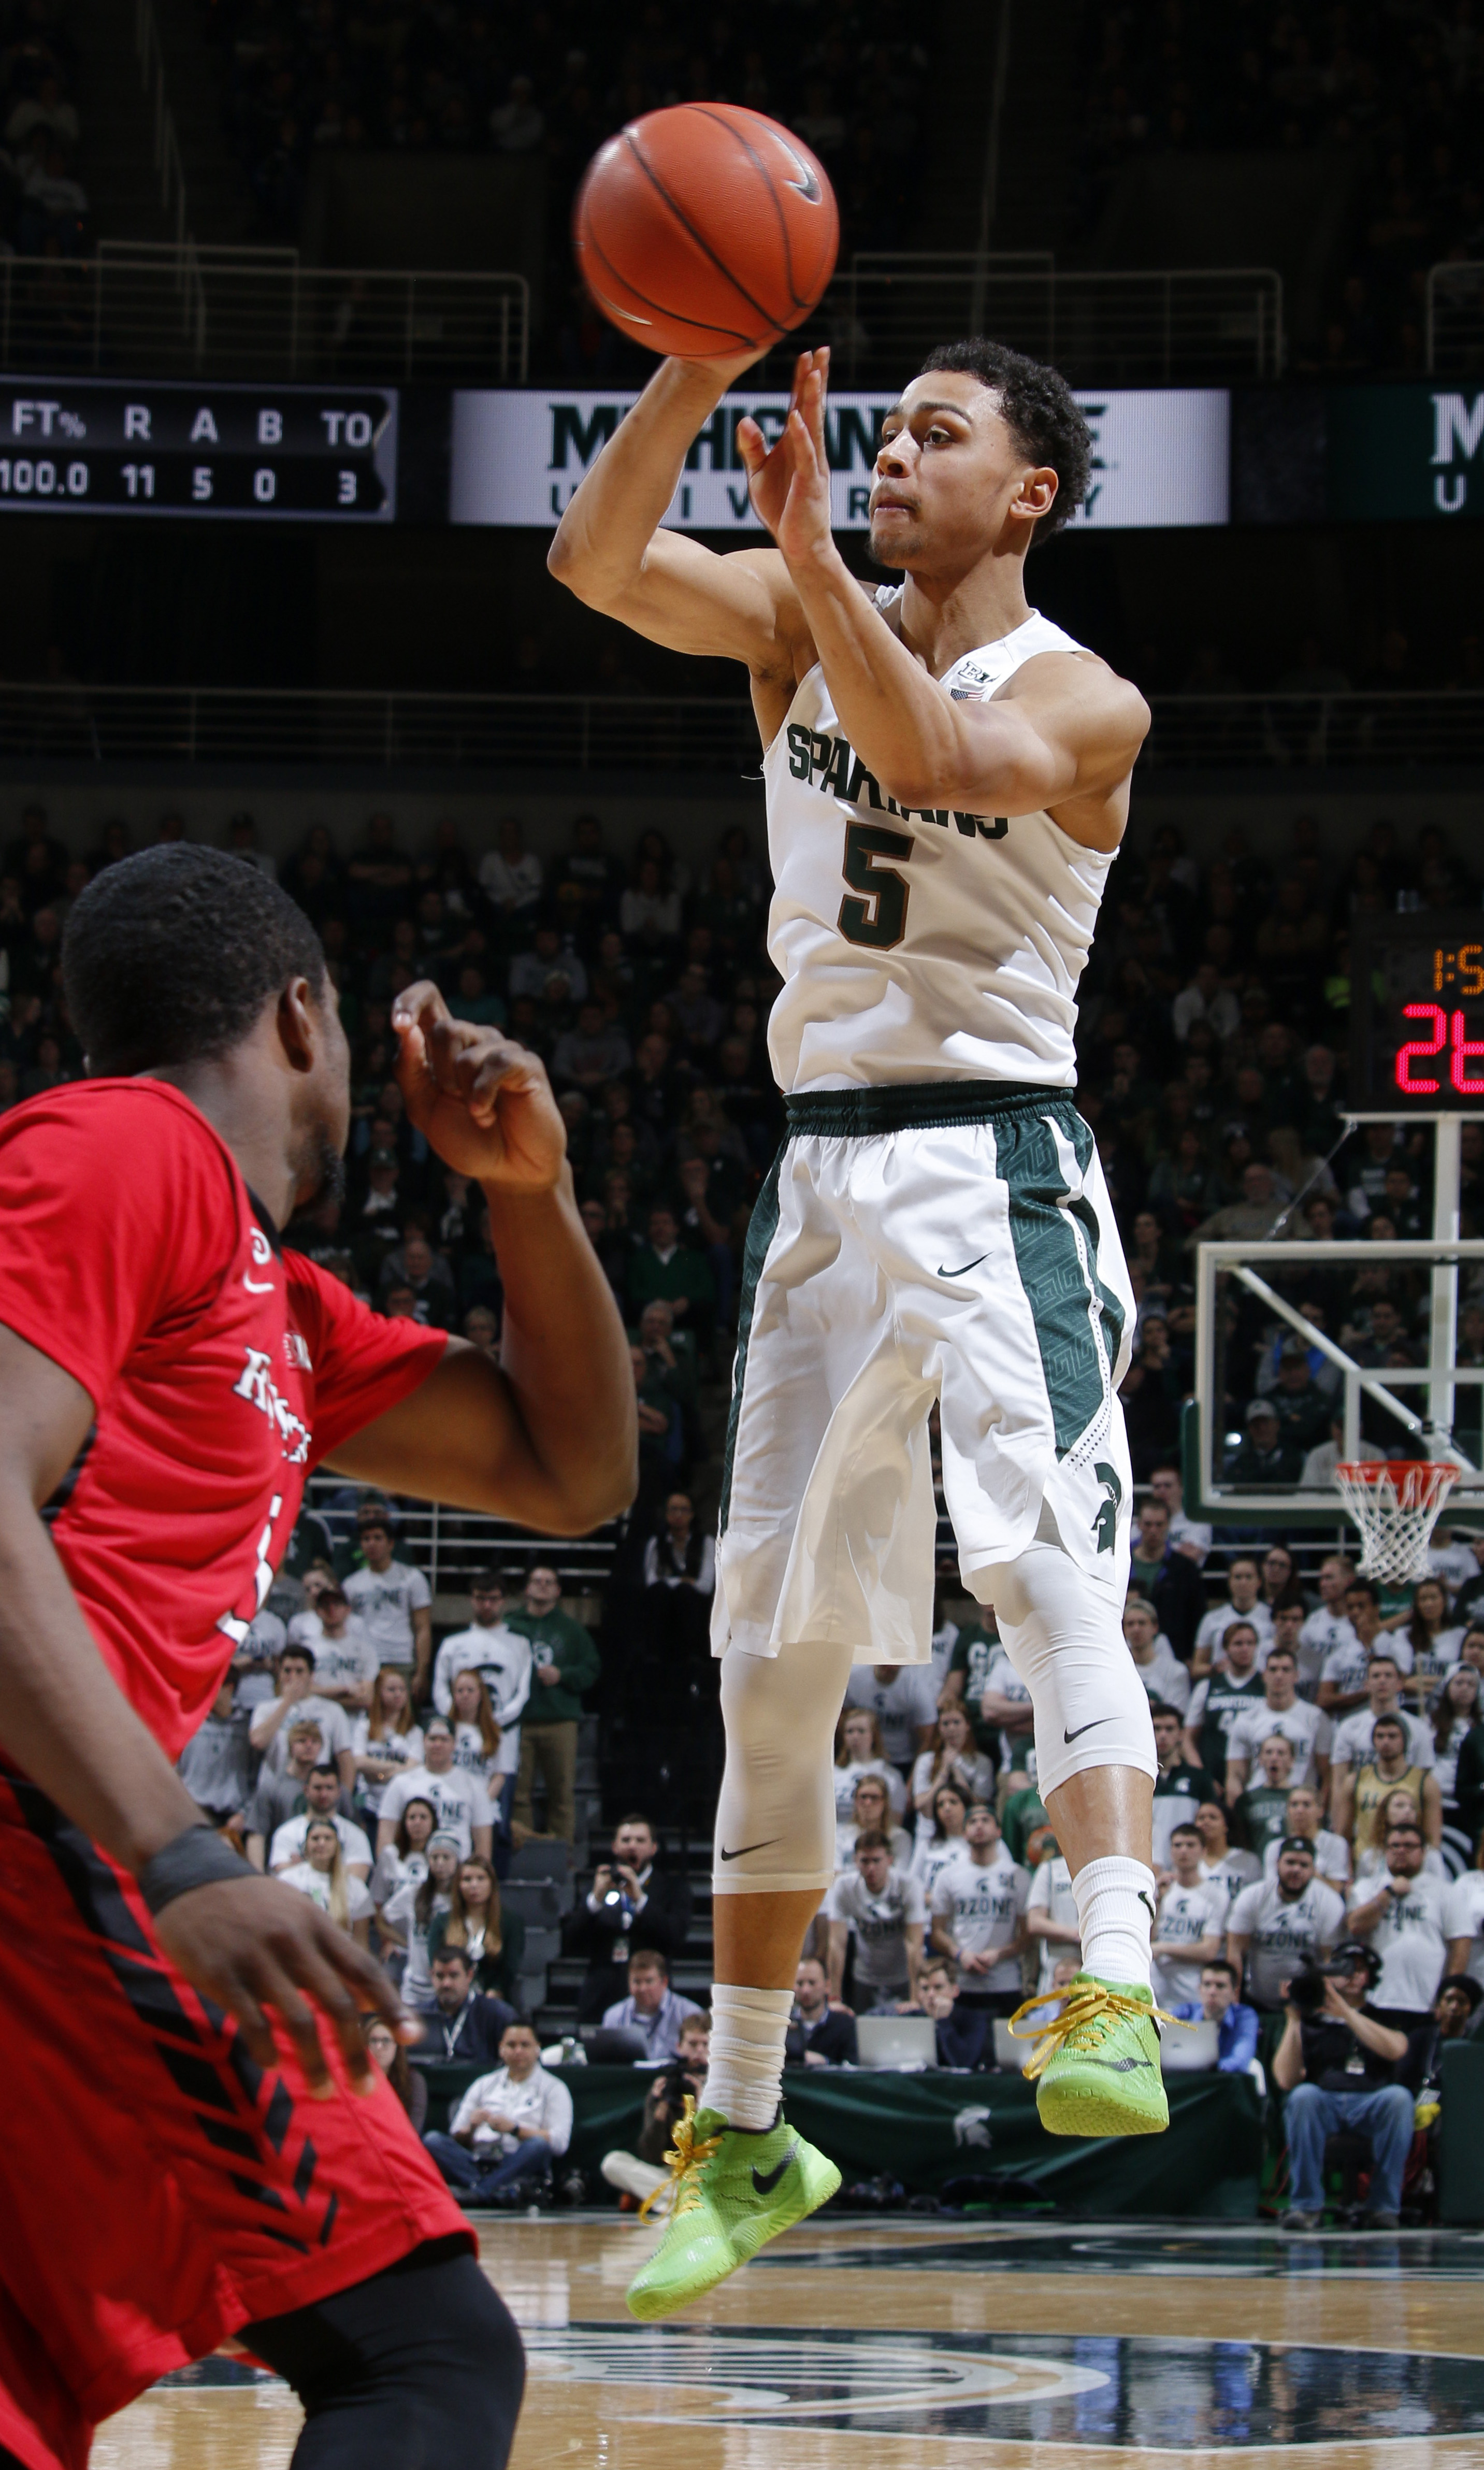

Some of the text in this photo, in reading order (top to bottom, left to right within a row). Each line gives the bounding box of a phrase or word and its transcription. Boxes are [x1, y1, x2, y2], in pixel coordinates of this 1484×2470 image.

[11, 400, 372, 448] FT% R A B TO
[122, 464, 154, 498] 11
[193, 467, 212, 500] 5
[254, 469, 276, 502] 0
[338, 472, 357, 504] 3
[838, 820, 914, 952] 5
